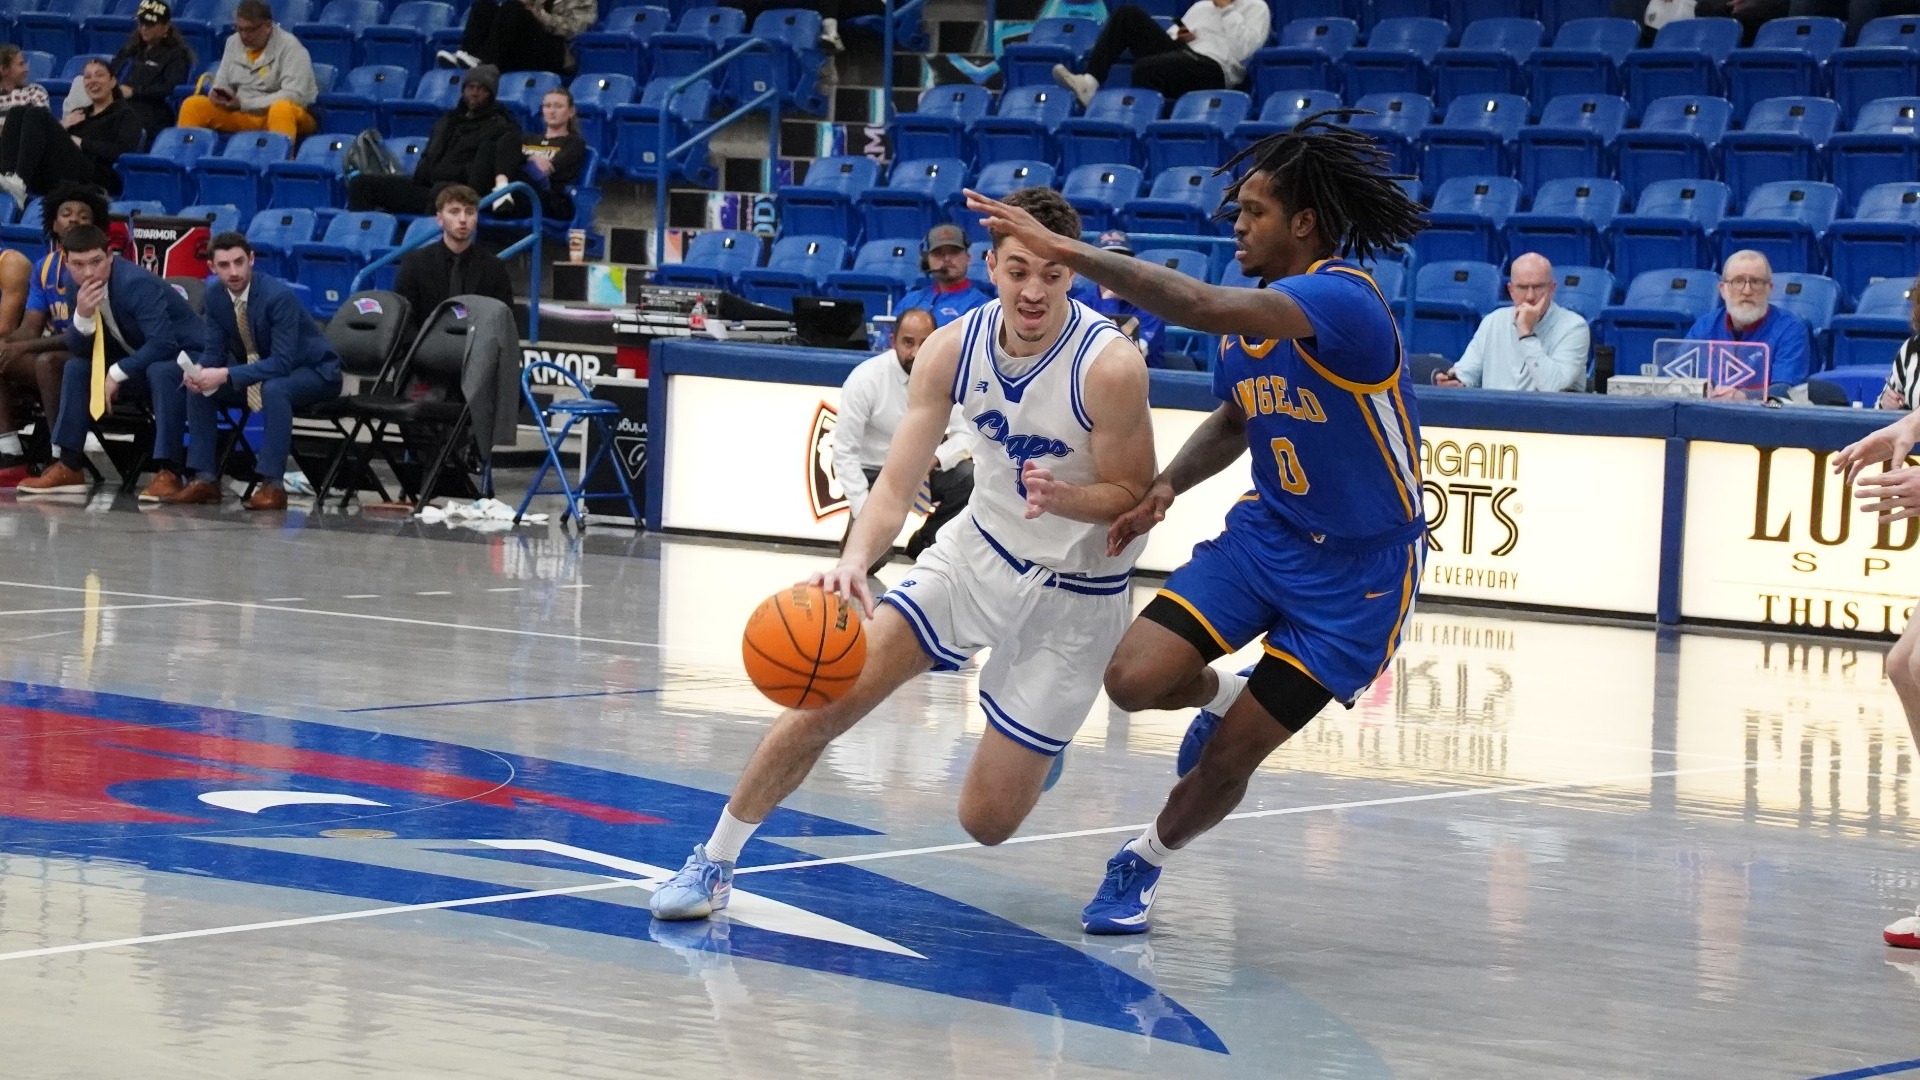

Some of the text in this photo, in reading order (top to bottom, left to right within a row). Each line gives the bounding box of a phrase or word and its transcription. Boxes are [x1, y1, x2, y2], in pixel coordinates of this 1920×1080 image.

[520, 350, 600, 387] RMOR
[1232, 375, 1328, 423] NGELO
[972, 409, 1075, 468] Chaps
[1270, 437, 1311, 495] 0
[1435, 565, 1518, 590] EVERYDAY
[1758, 594, 1860, 631] THIS
